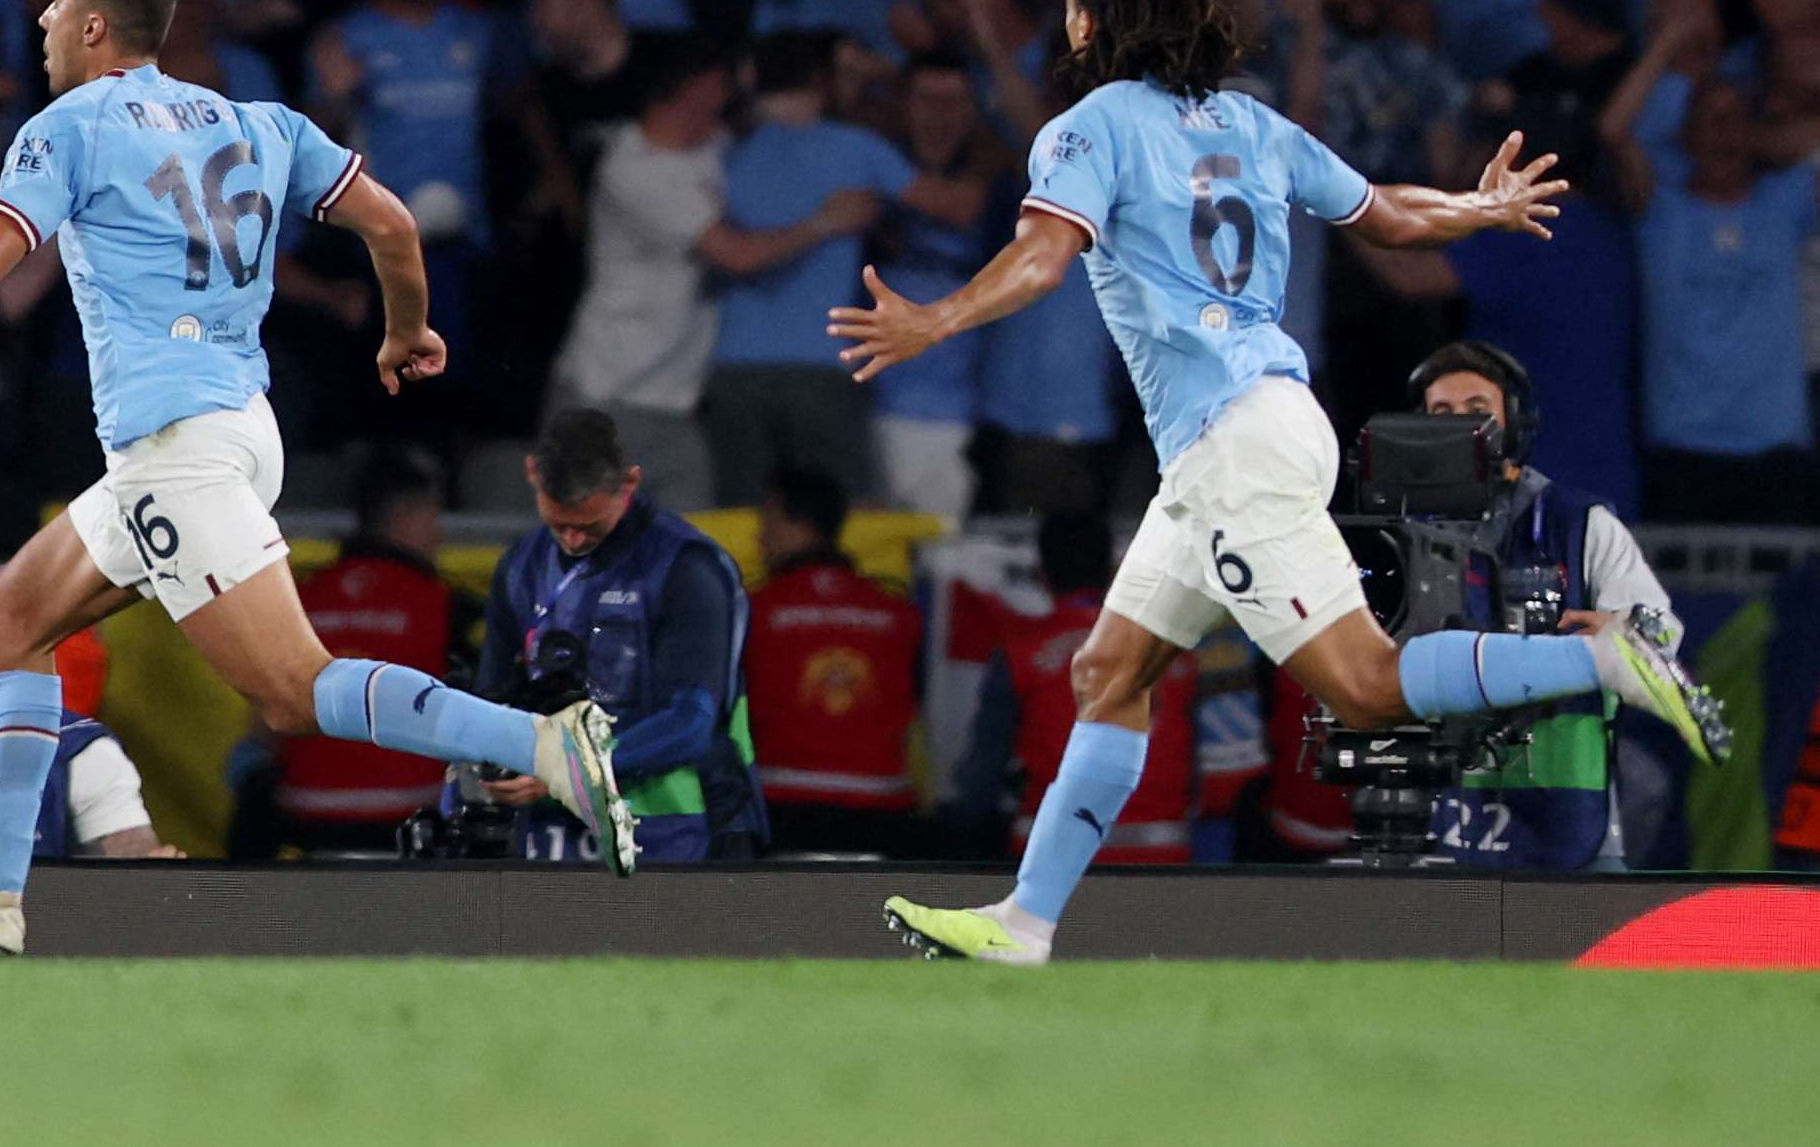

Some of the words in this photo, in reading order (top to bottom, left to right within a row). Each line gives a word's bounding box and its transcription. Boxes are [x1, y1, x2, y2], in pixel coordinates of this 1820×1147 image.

[143, 140, 274, 291] 16
[1189, 153, 1257, 297] 6
[125, 493, 179, 570] 16
[1211, 529, 1253, 594] 6
